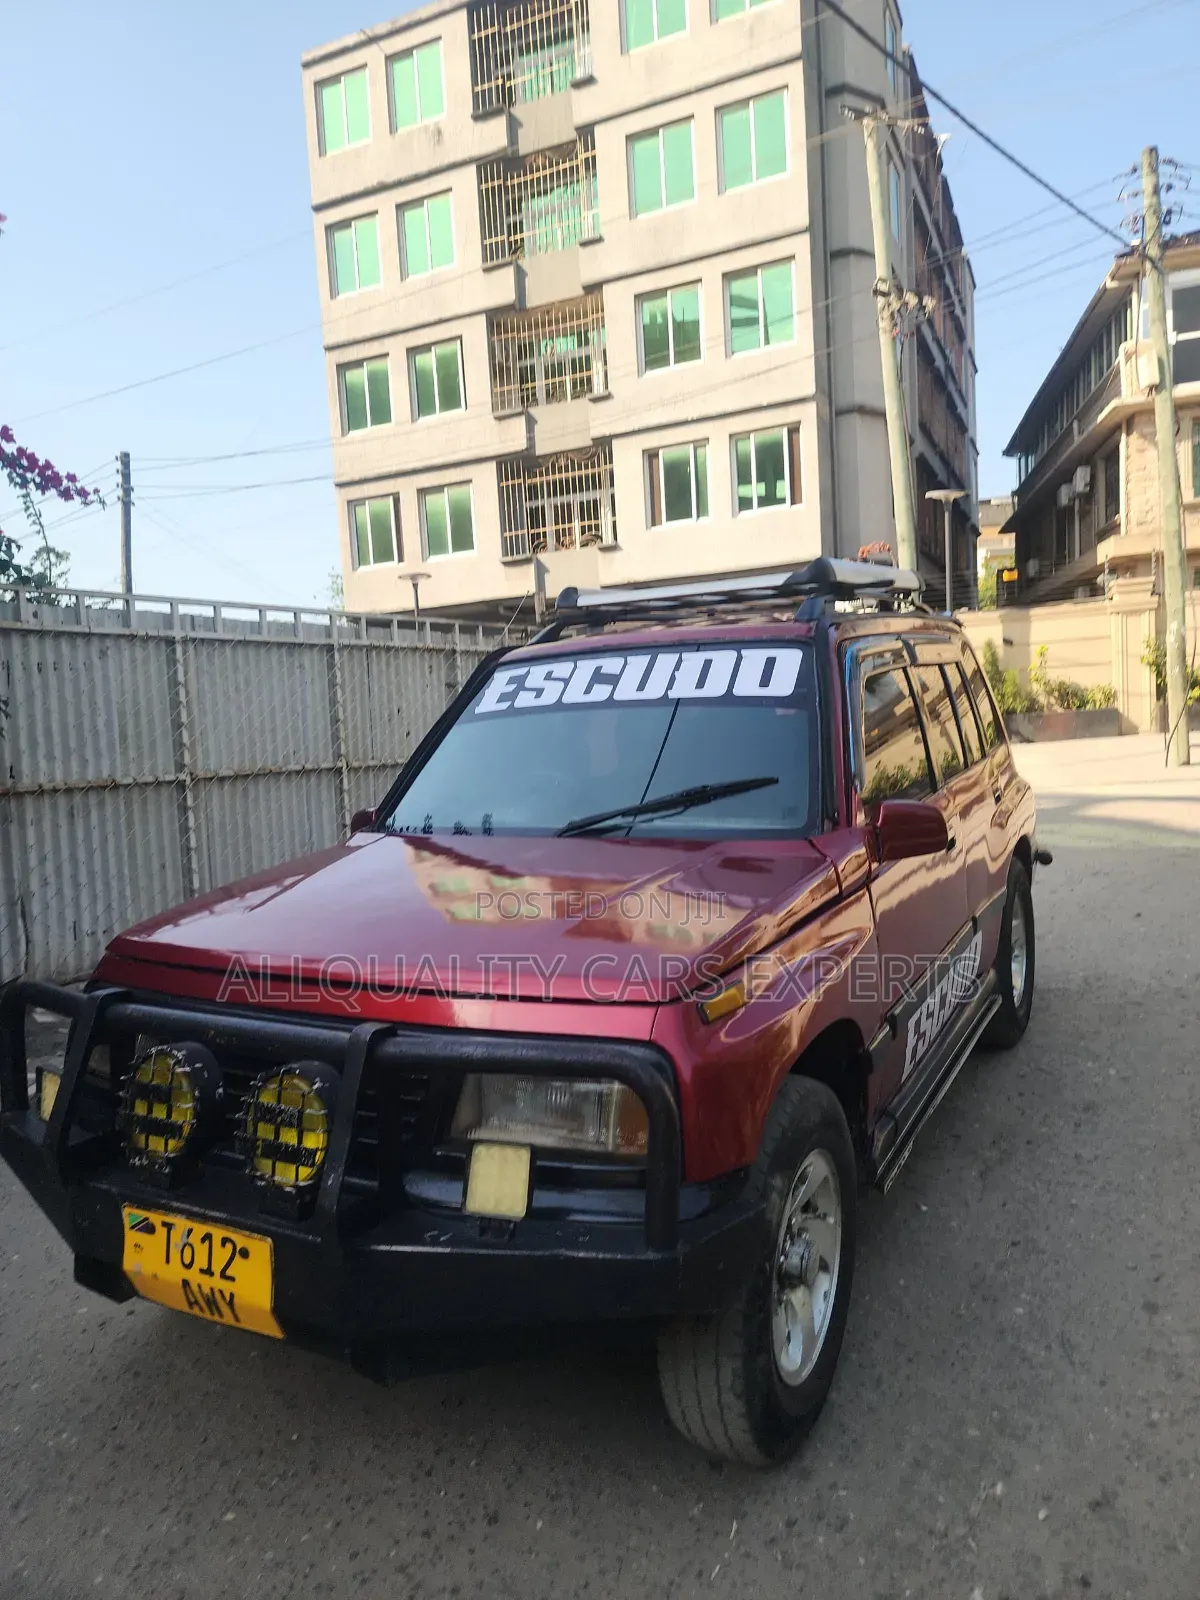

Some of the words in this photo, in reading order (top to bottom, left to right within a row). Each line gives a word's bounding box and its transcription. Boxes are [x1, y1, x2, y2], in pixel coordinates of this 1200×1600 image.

[475, 648, 803, 714] ESCUDO
[161, 1220, 237, 1282] T612
[181, 1278, 241, 1313] AWY
